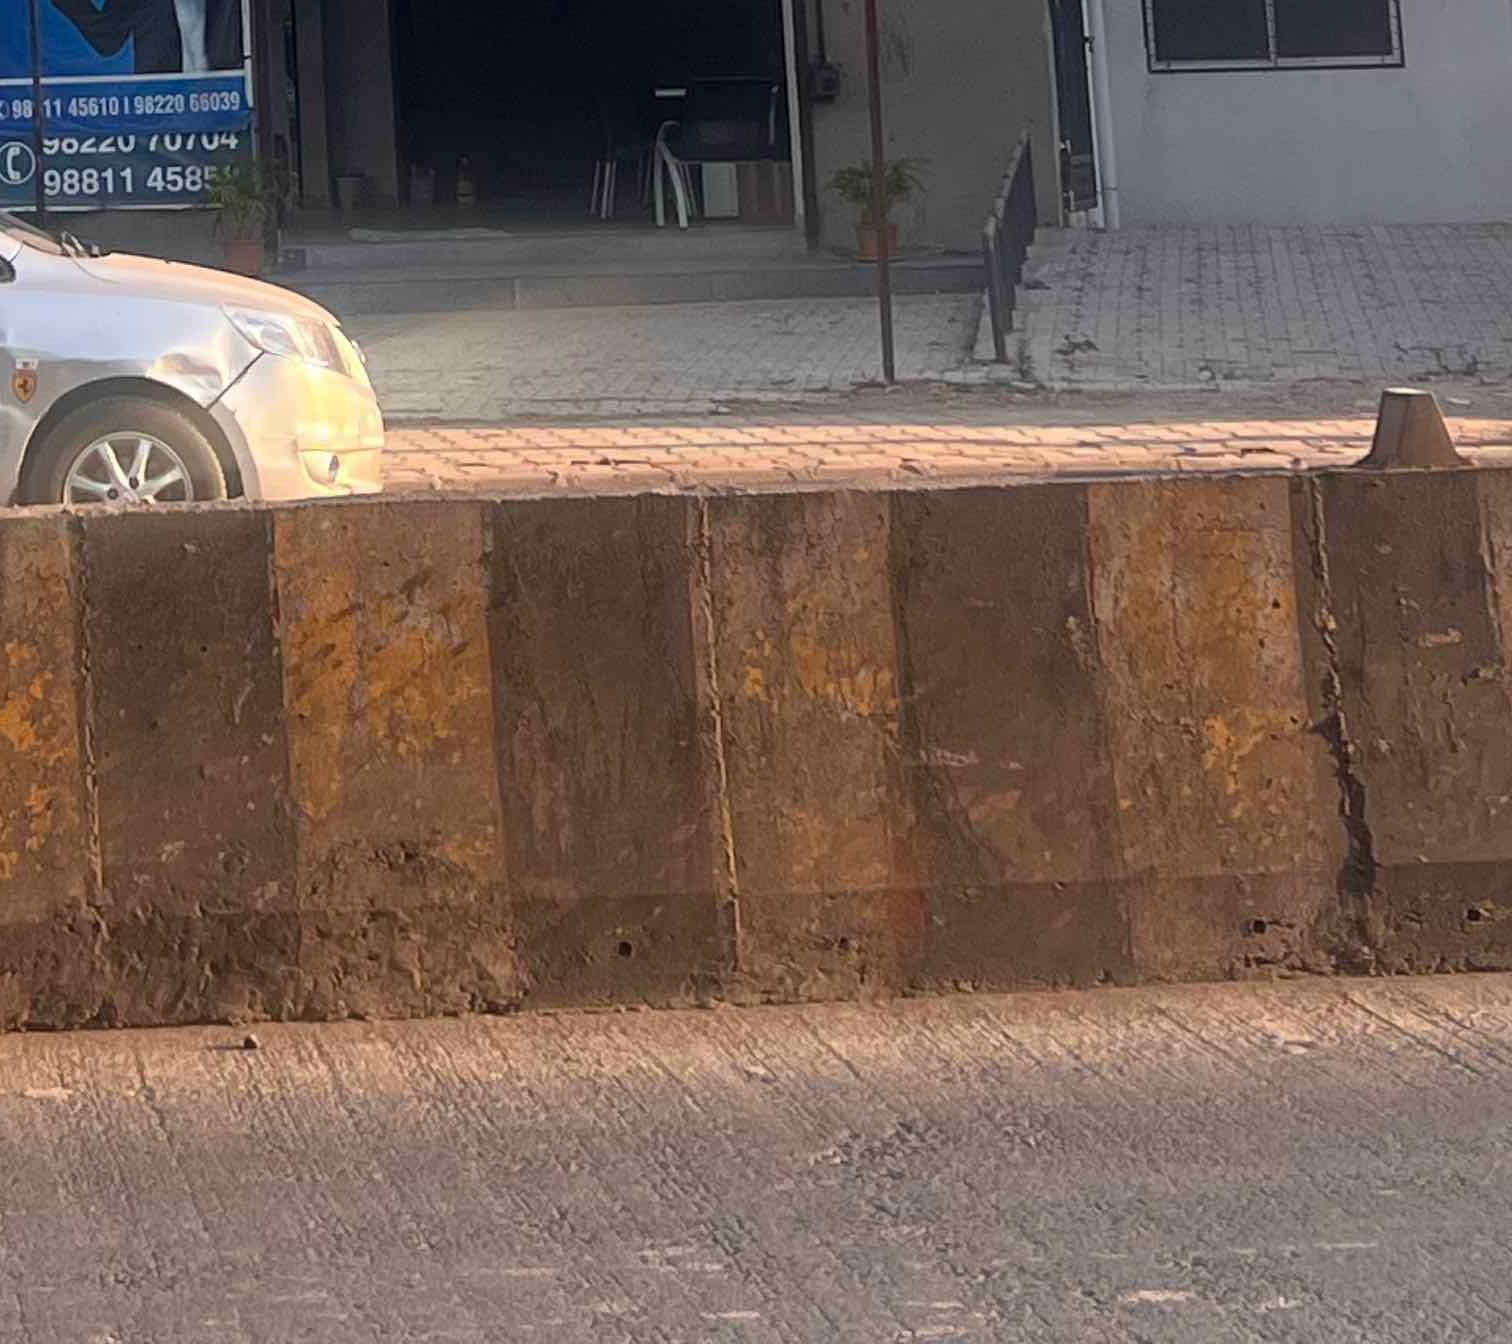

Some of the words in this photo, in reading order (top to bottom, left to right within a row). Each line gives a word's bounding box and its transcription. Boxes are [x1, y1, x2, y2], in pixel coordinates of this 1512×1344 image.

[11, 98, 62, 120] 9811
[67, 95, 119, 119] 45610
[133, 94, 186, 116] 98220
[189, 91, 241, 113] 66039
[43, 166, 133, 196] 98811
